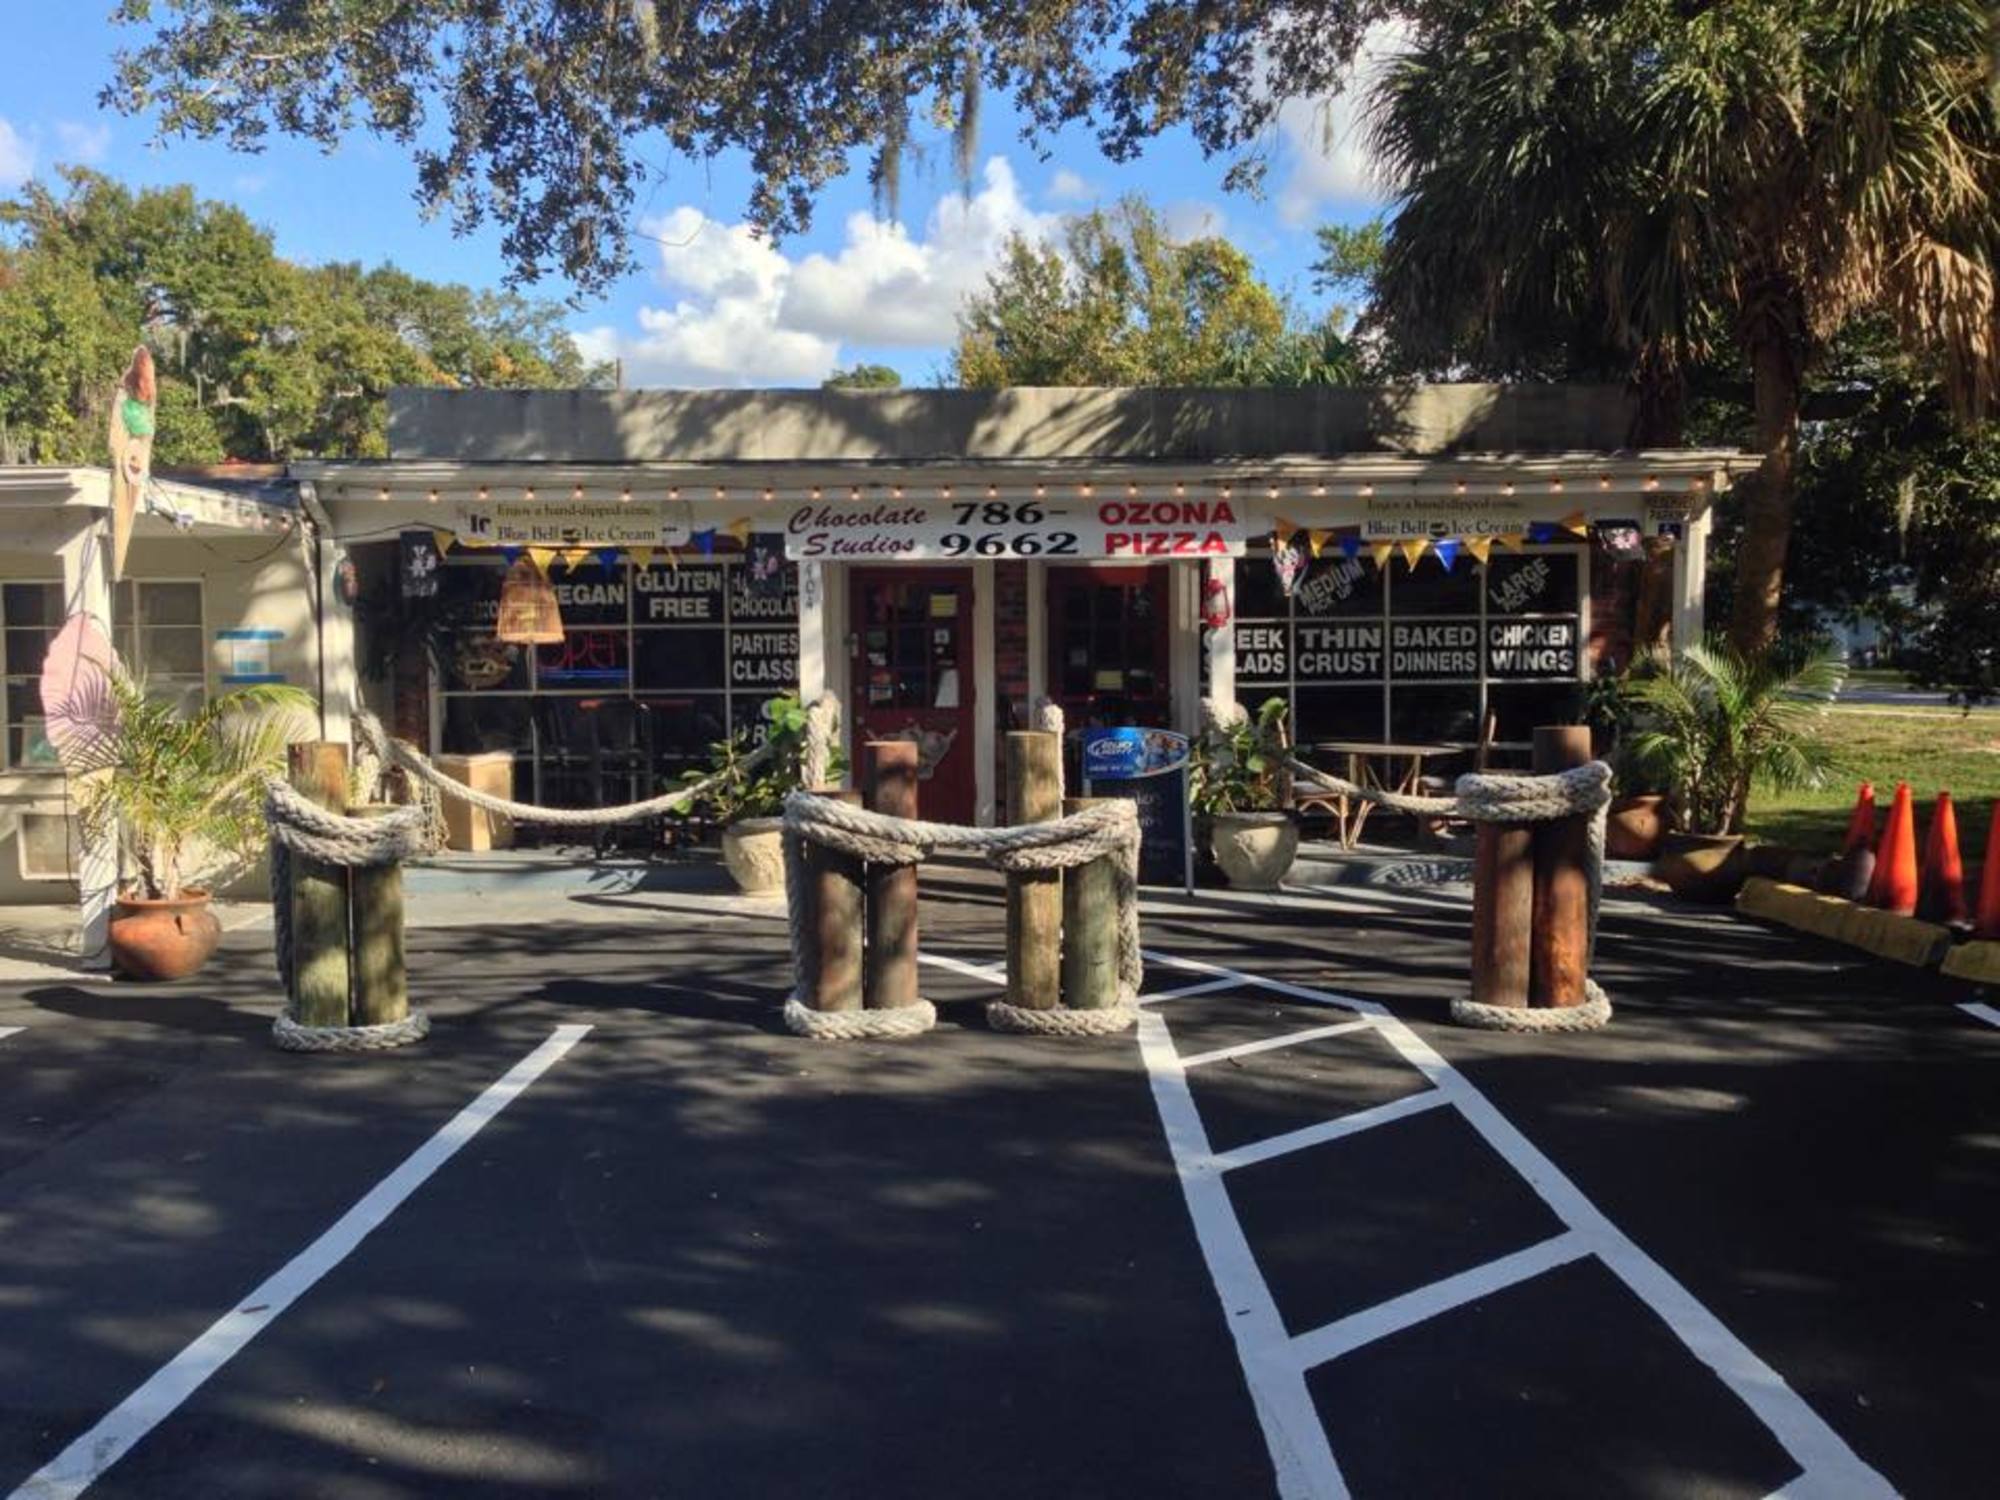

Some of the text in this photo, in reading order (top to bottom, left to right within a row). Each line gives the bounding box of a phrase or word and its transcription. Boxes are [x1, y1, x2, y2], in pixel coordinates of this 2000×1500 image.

[788, 504, 927, 534] Chocolate
[951, 501, 1068, 526] 786-
[1099, 501, 1236, 525] OZONA
[498, 525, 528, 540] Blue
[532, 525, 558, 540] Bell
[585, 525, 606, 540] Ice
[608, 525, 655, 541] Cream
[1368, 519, 1523, 534] Blue Bell Ice Cream
[803, 533, 914, 555] Studios
[939, 531, 1078, 557] 9662
[1105, 532, 1227, 555] PIZZA
[635, 570, 723, 593] GLUTEN
[1299, 556, 1366, 608] MEDIUM
[1489, 557, 1551, 606] LARGE
[554, 584, 625, 606] EGAN
[649, 597, 711, 619] FREE
[732, 632, 800, 655] PARTIES
[1203, 629, 1284, 650] EEK
[1298, 628, 1382, 649] THIN
[1393, 626, 1477, 647] BAKED
[1490, 625, 1574, 647] CHICKEN
[732, 660, 800, 681] CLASS
[1300, 653, 1381, 674] CRUST
[1393, 651, 1477, 672] DINNERS
[1492, 648, 1574, 671] WINGS
